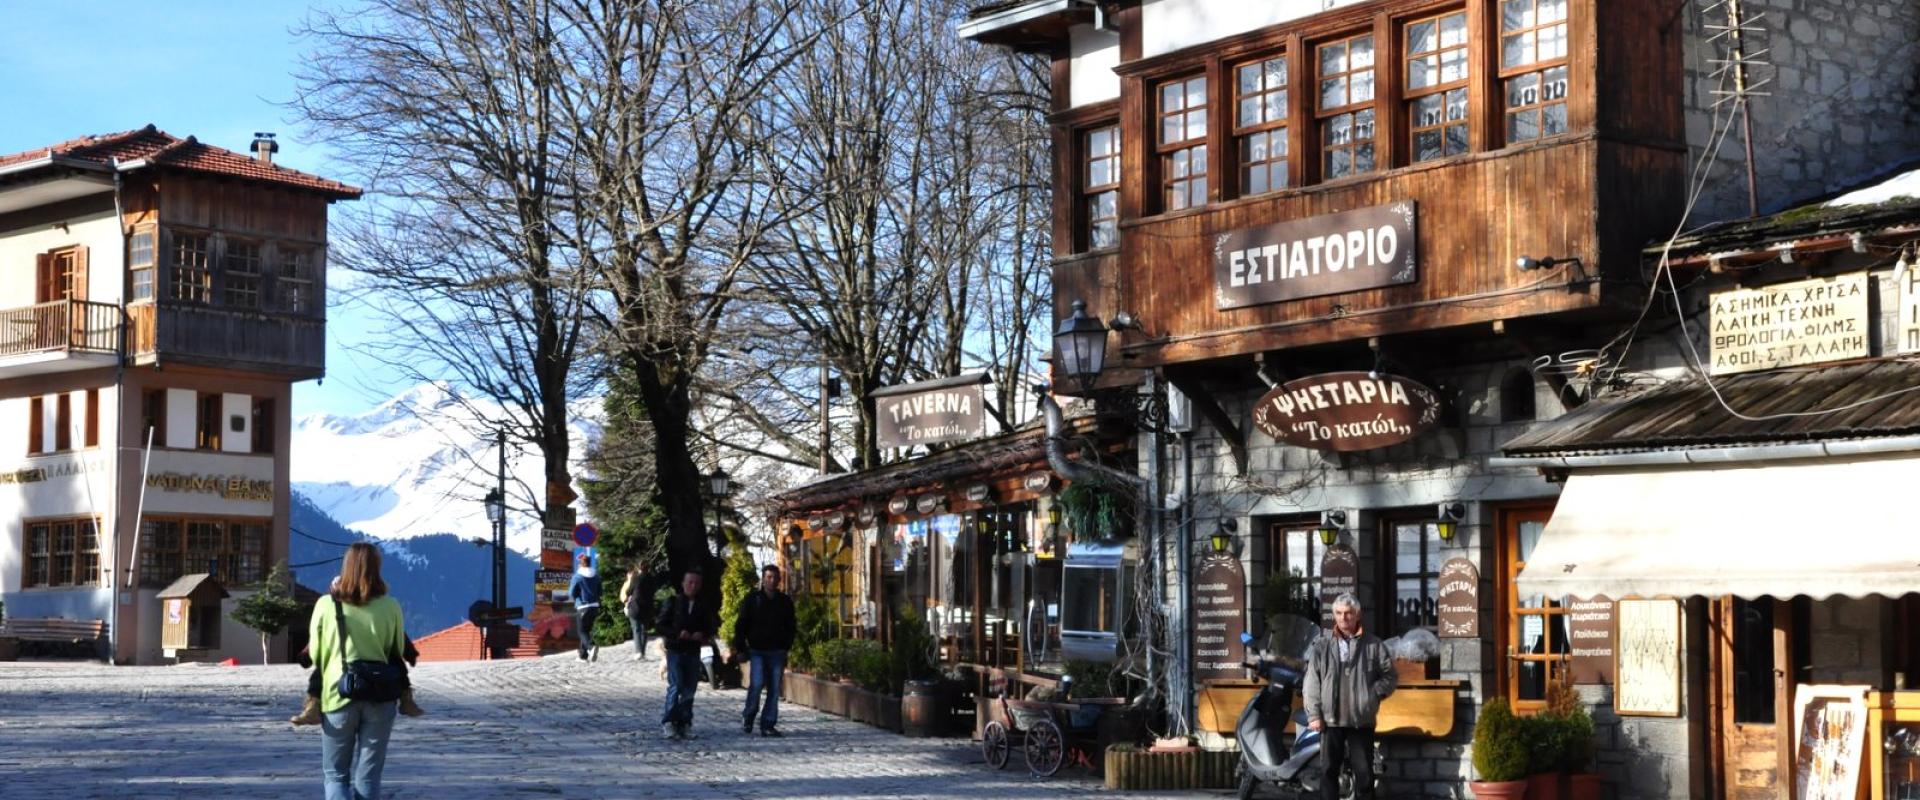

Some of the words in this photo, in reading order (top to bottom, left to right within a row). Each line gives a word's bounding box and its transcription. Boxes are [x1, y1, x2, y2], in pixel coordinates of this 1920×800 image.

[1230, 225, 1397, 287] ΕΣΤΙΑΤΟΡΙΟ
[1778, 303, 1835, 323] ΤΕΧΝΗ
[889, 392, 971, 424] TAVERNA
[1272, 379, 1410, 417] ΨΗΣΤΑΡΙΑ
